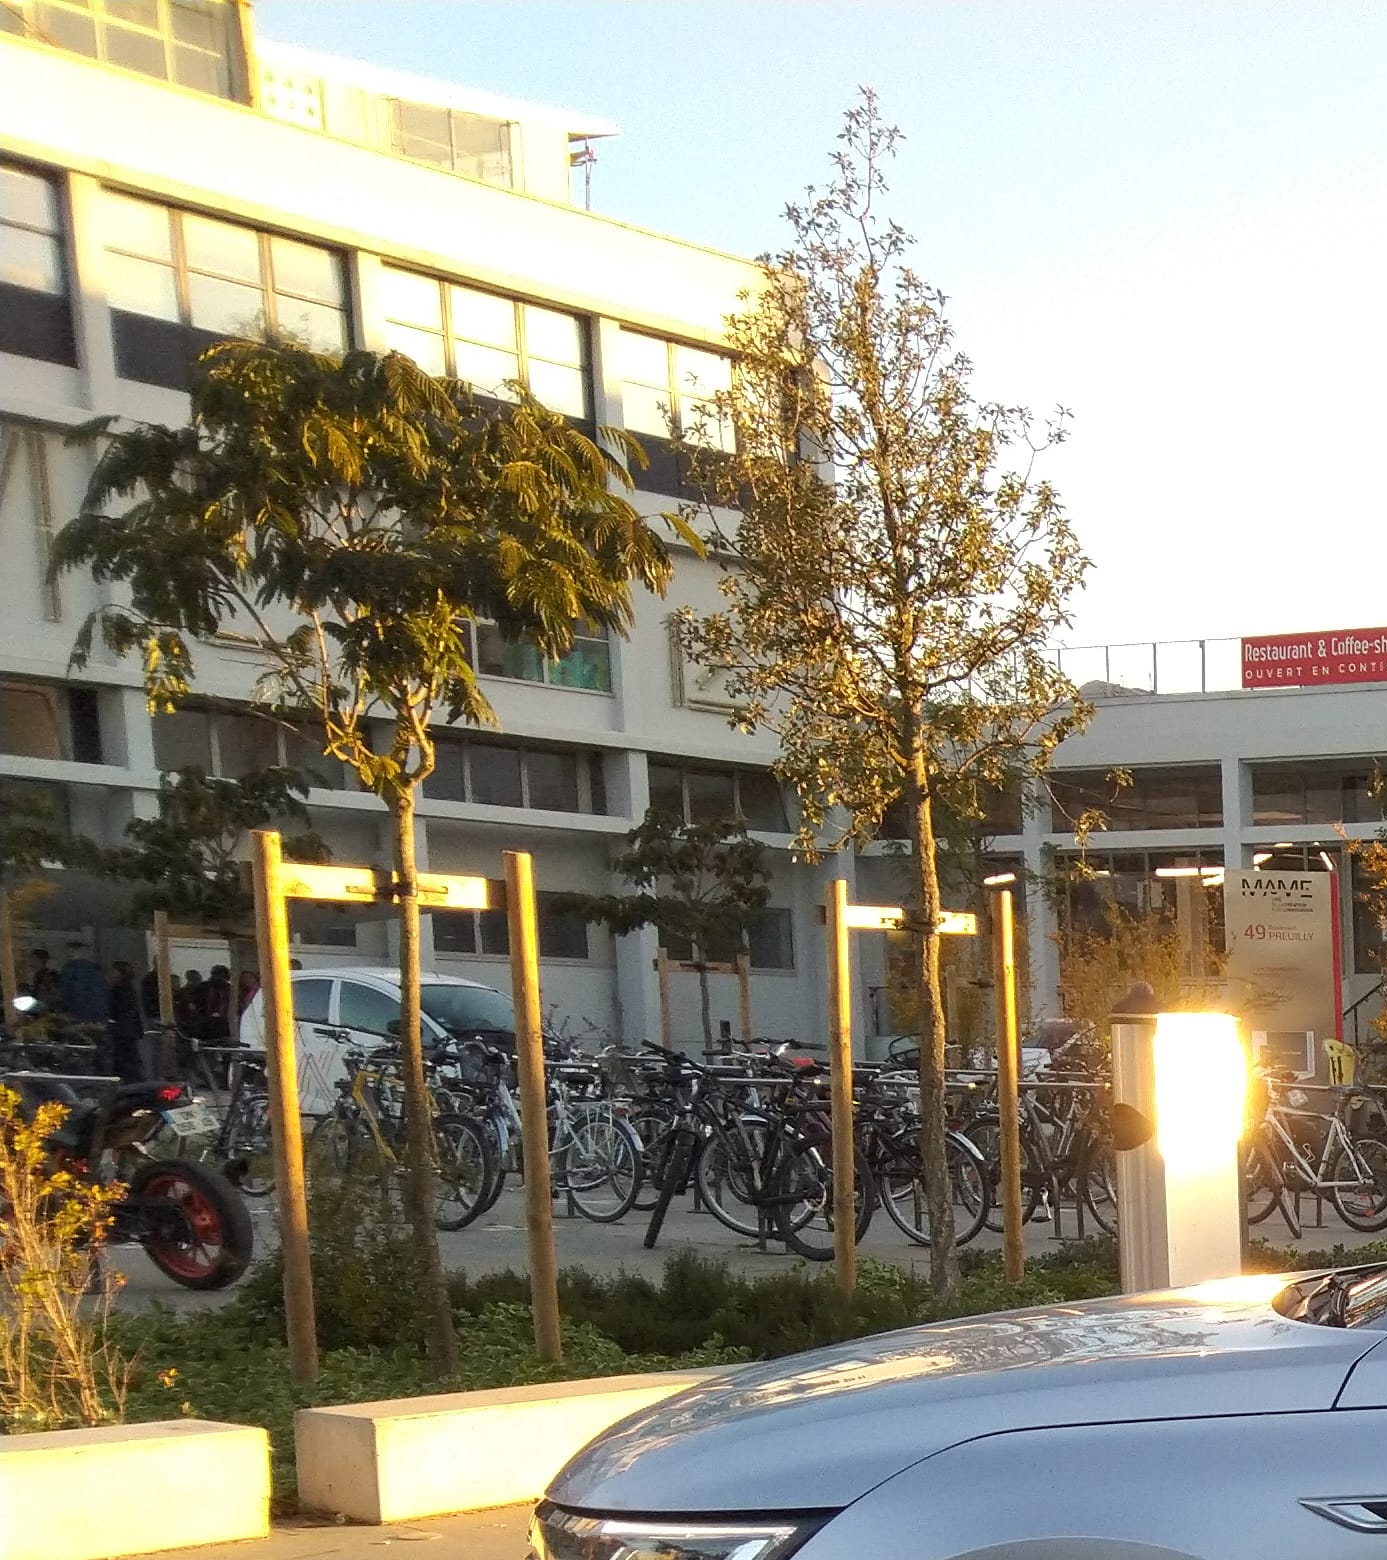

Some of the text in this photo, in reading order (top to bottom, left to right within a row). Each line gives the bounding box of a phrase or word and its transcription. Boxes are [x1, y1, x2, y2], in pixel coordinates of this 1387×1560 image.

[1245, 641, 1313, 662] Restaurant
[1317, 639, 1327, 658] &
[1245, 666, 1303, 680] OUVERT
[1312, 665, 1329, 676] EN
[1241, 878, 1313, 898] MAME
[1244, 924, 1266, 940] 49
[1269, 930, 1314, 942] PREUILLY
